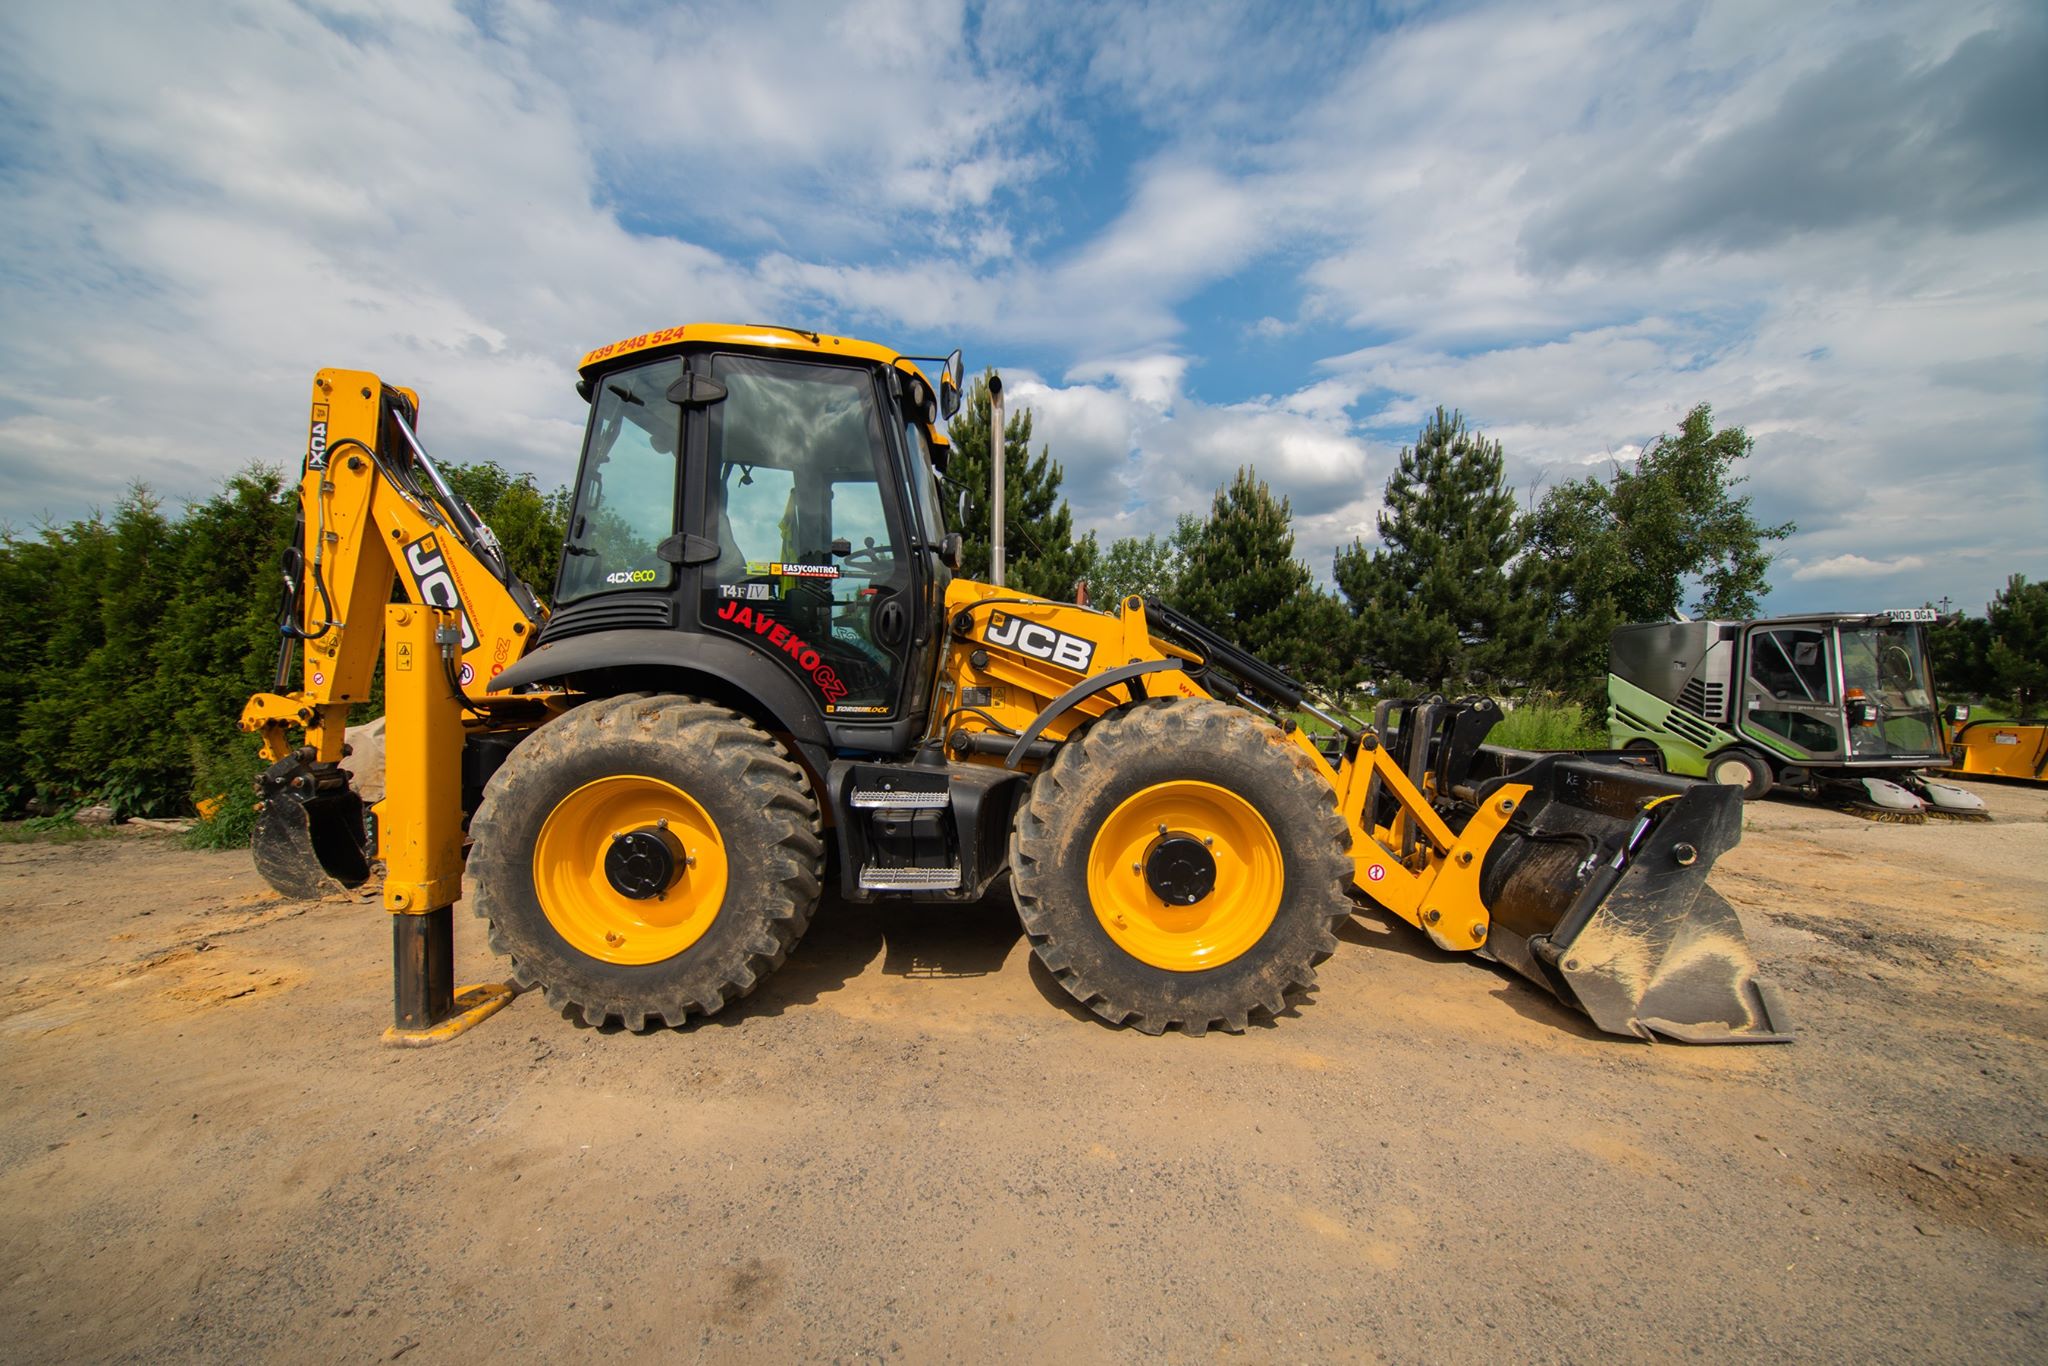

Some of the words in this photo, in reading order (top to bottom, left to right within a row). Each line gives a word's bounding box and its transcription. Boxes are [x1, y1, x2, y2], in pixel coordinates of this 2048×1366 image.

[588, 344, 614, 362] 739
[617, 334, 648, 353] 248
[651, 326, 685, 344] 524
[782, 564, 839, 575] EASYCONTROL
[987, 618, 1092, 670] JCB
